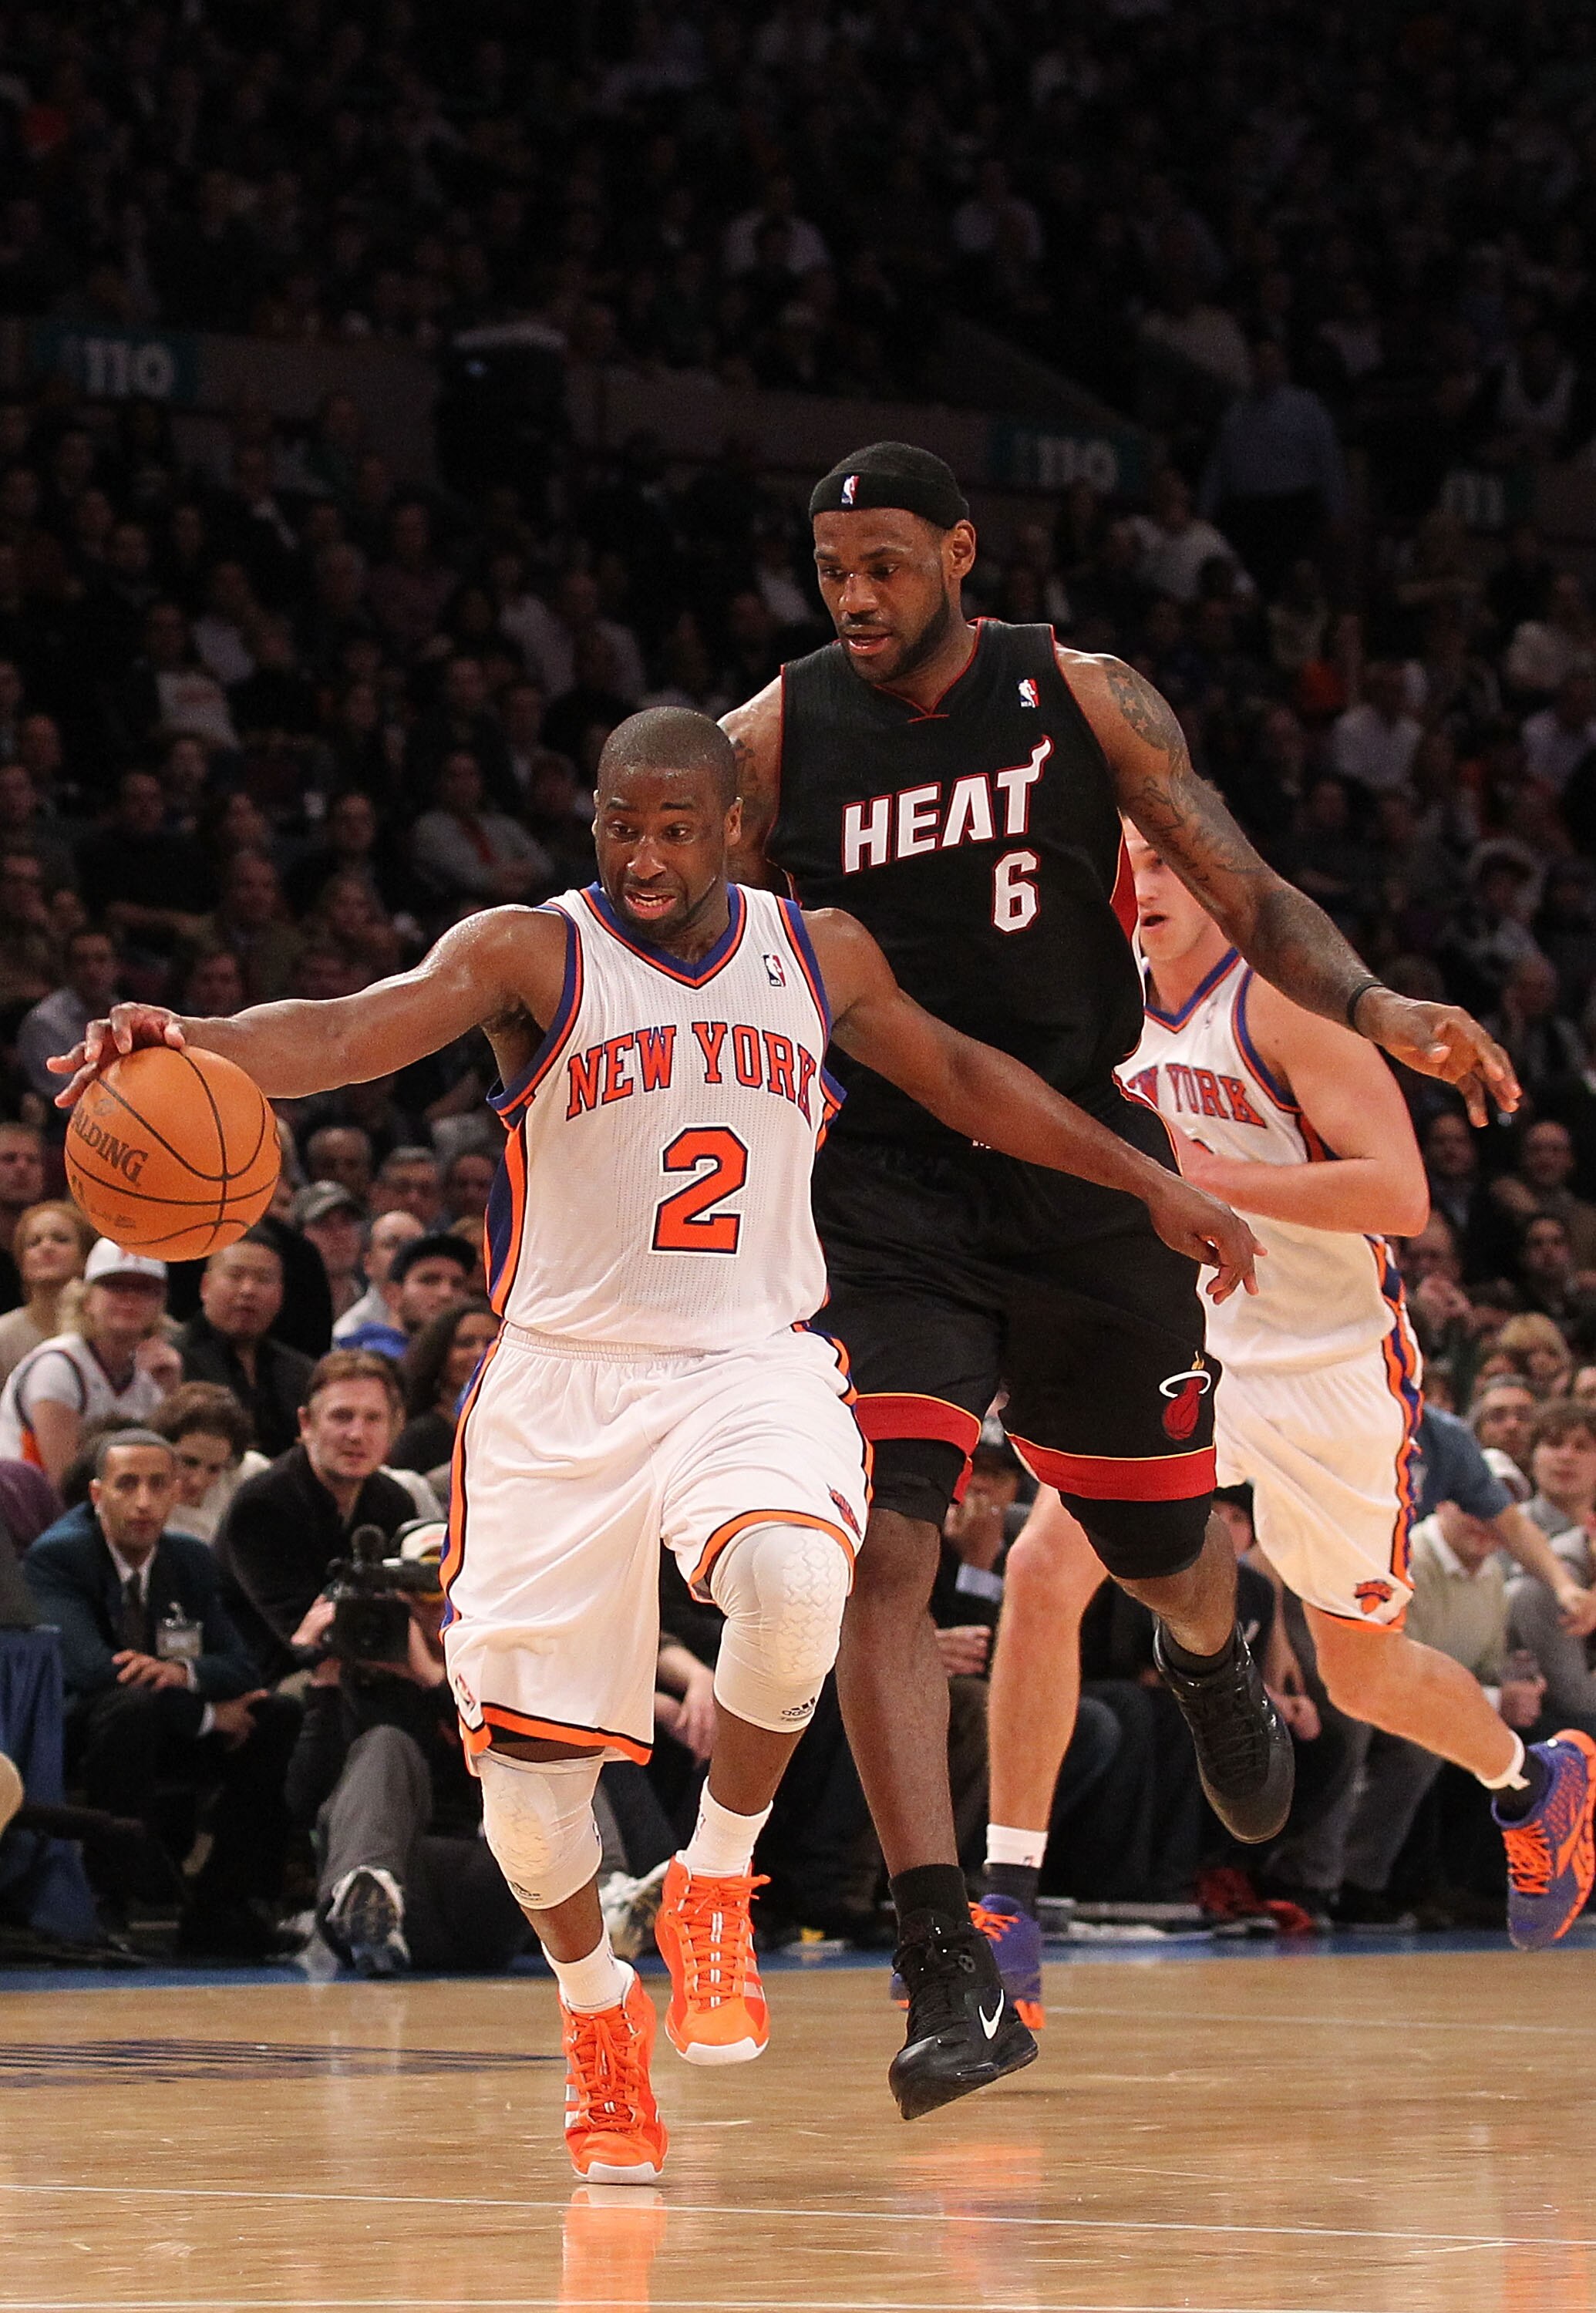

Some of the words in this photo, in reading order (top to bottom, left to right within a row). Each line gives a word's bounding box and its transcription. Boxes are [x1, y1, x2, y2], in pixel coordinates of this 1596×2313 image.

[842, 734, 1055, 876] HEAT
[992, 848, 1042, 935] 6
[565, 1023, 678, 1122] NEW
[691, 1021, 818, 1131] YORK
[650, 1124, 749, 1257] 2
